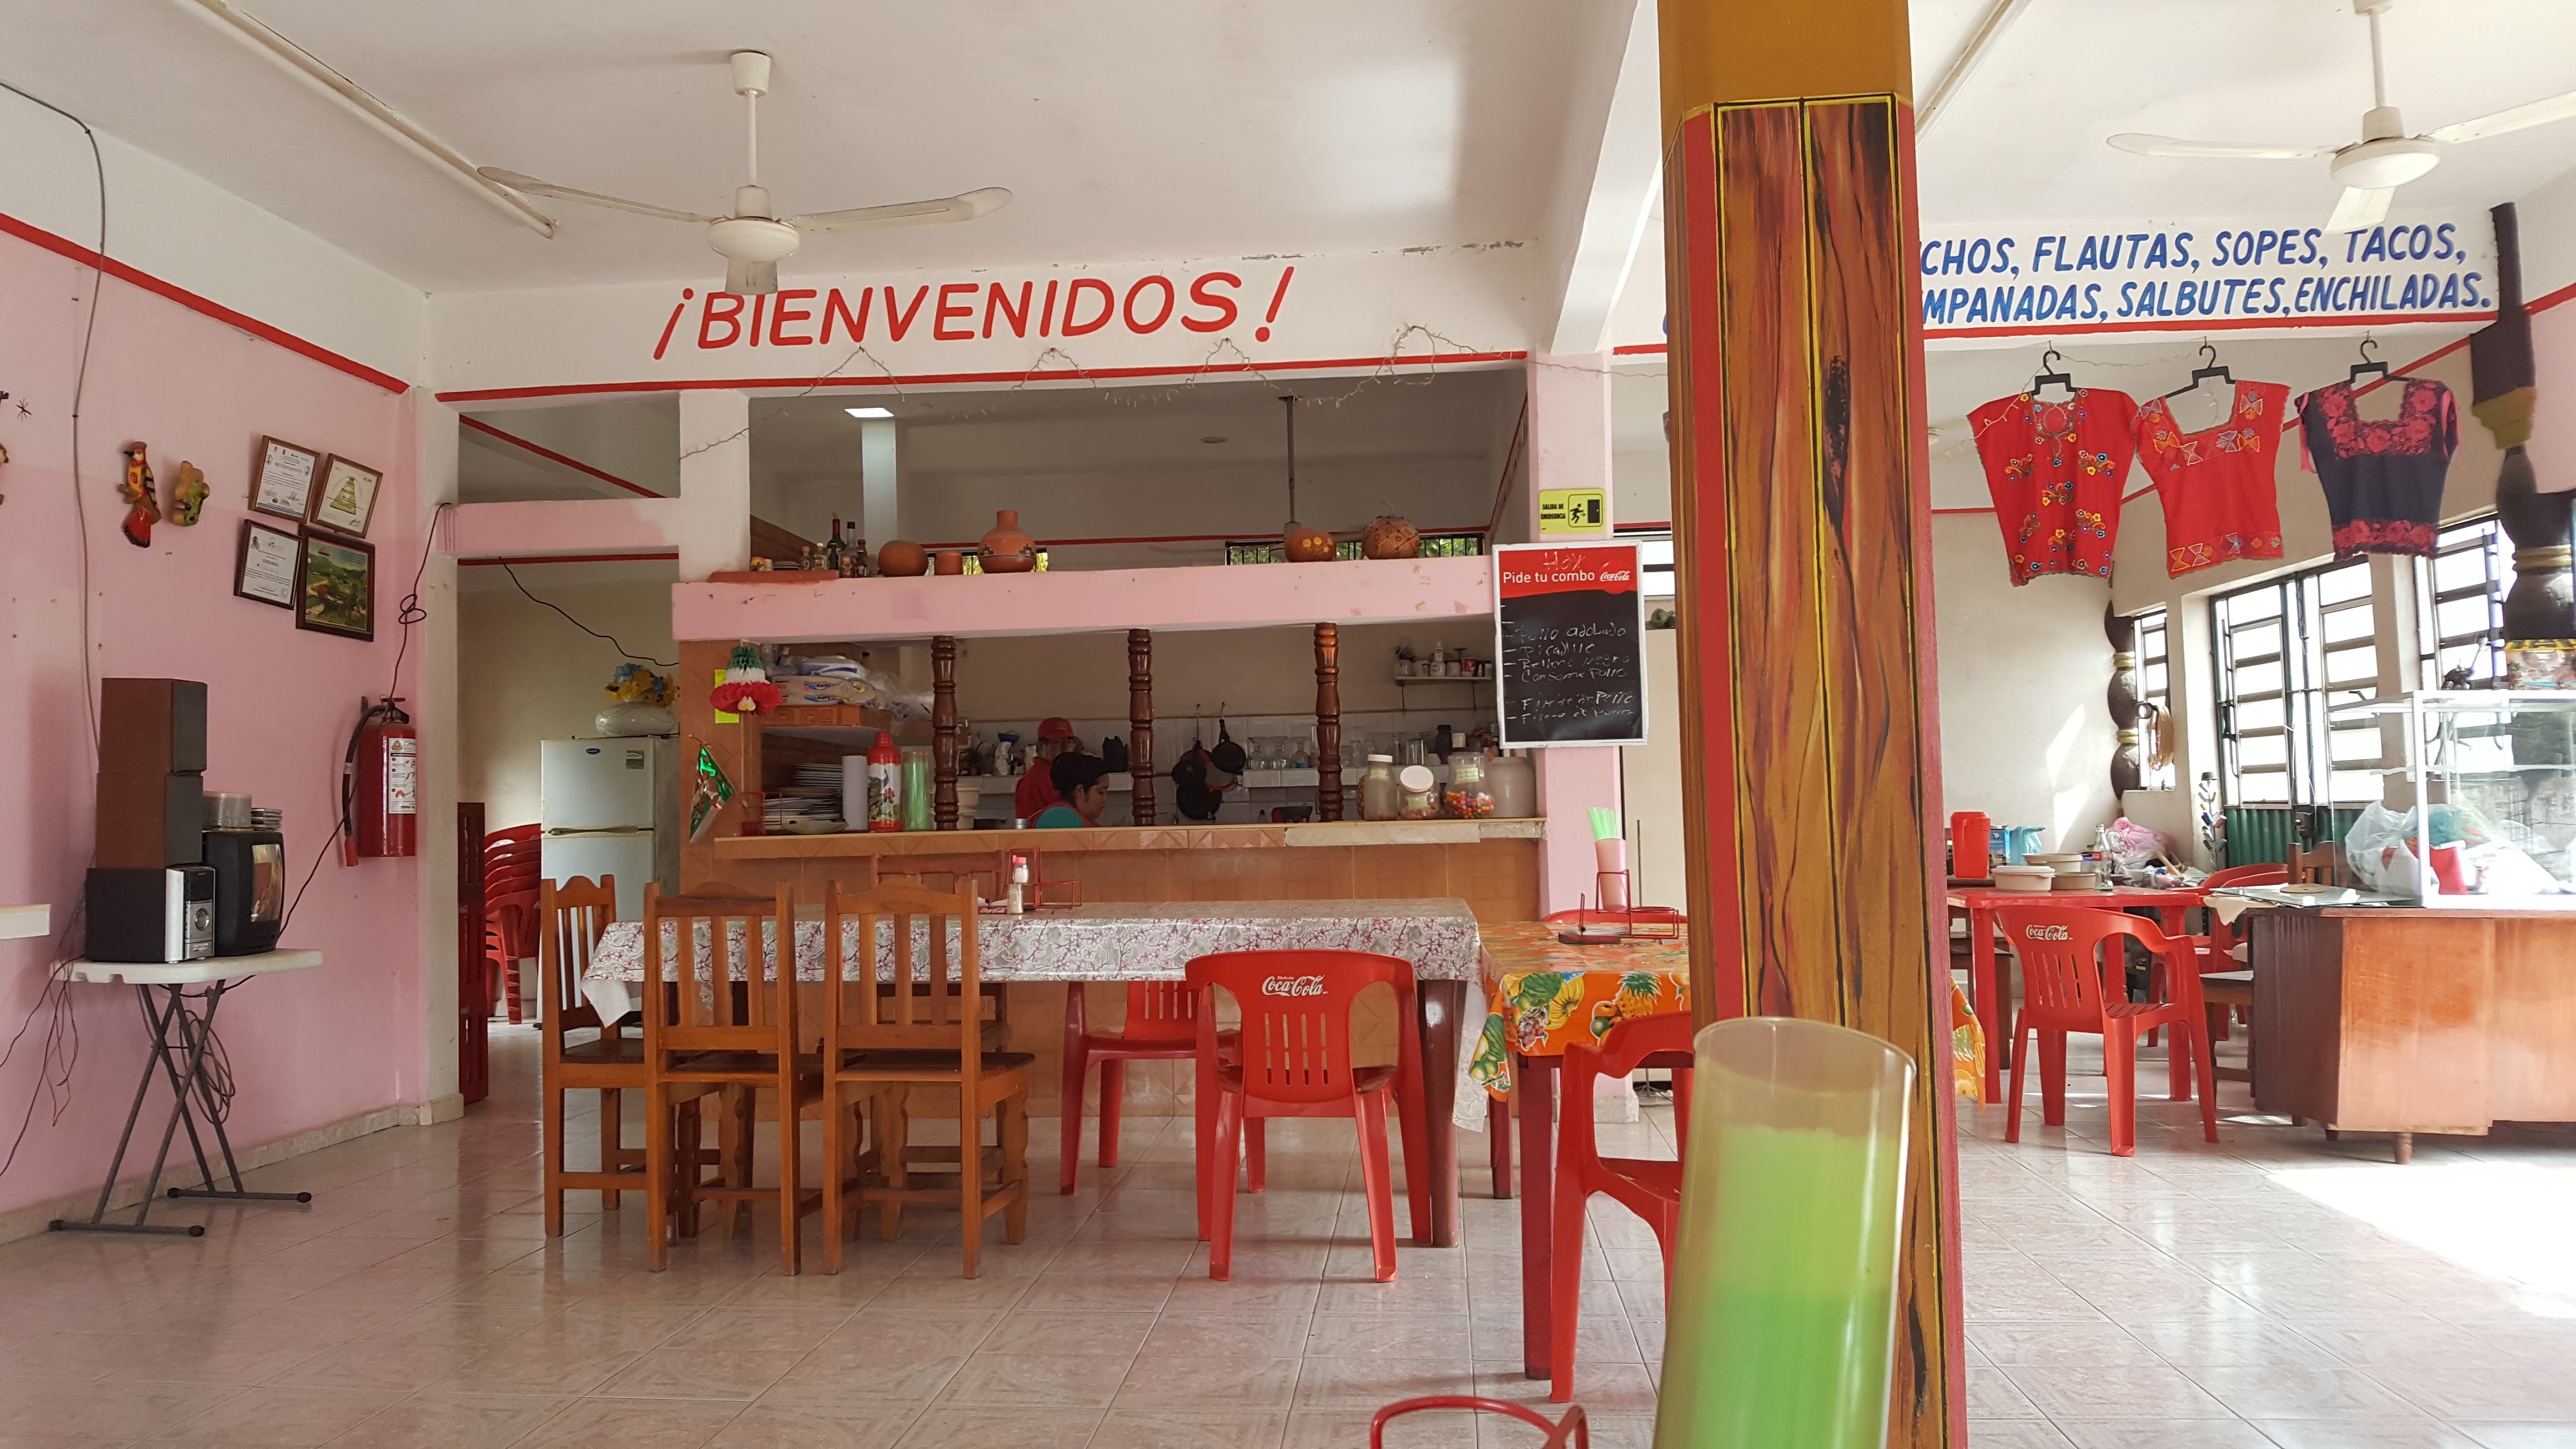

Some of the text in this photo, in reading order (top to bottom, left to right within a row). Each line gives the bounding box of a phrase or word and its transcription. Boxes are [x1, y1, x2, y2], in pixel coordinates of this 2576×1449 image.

[1919, 223, 2466, 280] CHOS, FLAUTAS, SOPES, TACOS,
[1922, 272, 2491, 324] MPANADAS, SALBUTES, ENCHILADAS.
[1503, 572, 1531, 584] Pide
[1535, 573, 1548, 583] tu
[1552, 570, 1595, 582] combo
[1262, 975, 1326, 997] Coca-Cola
